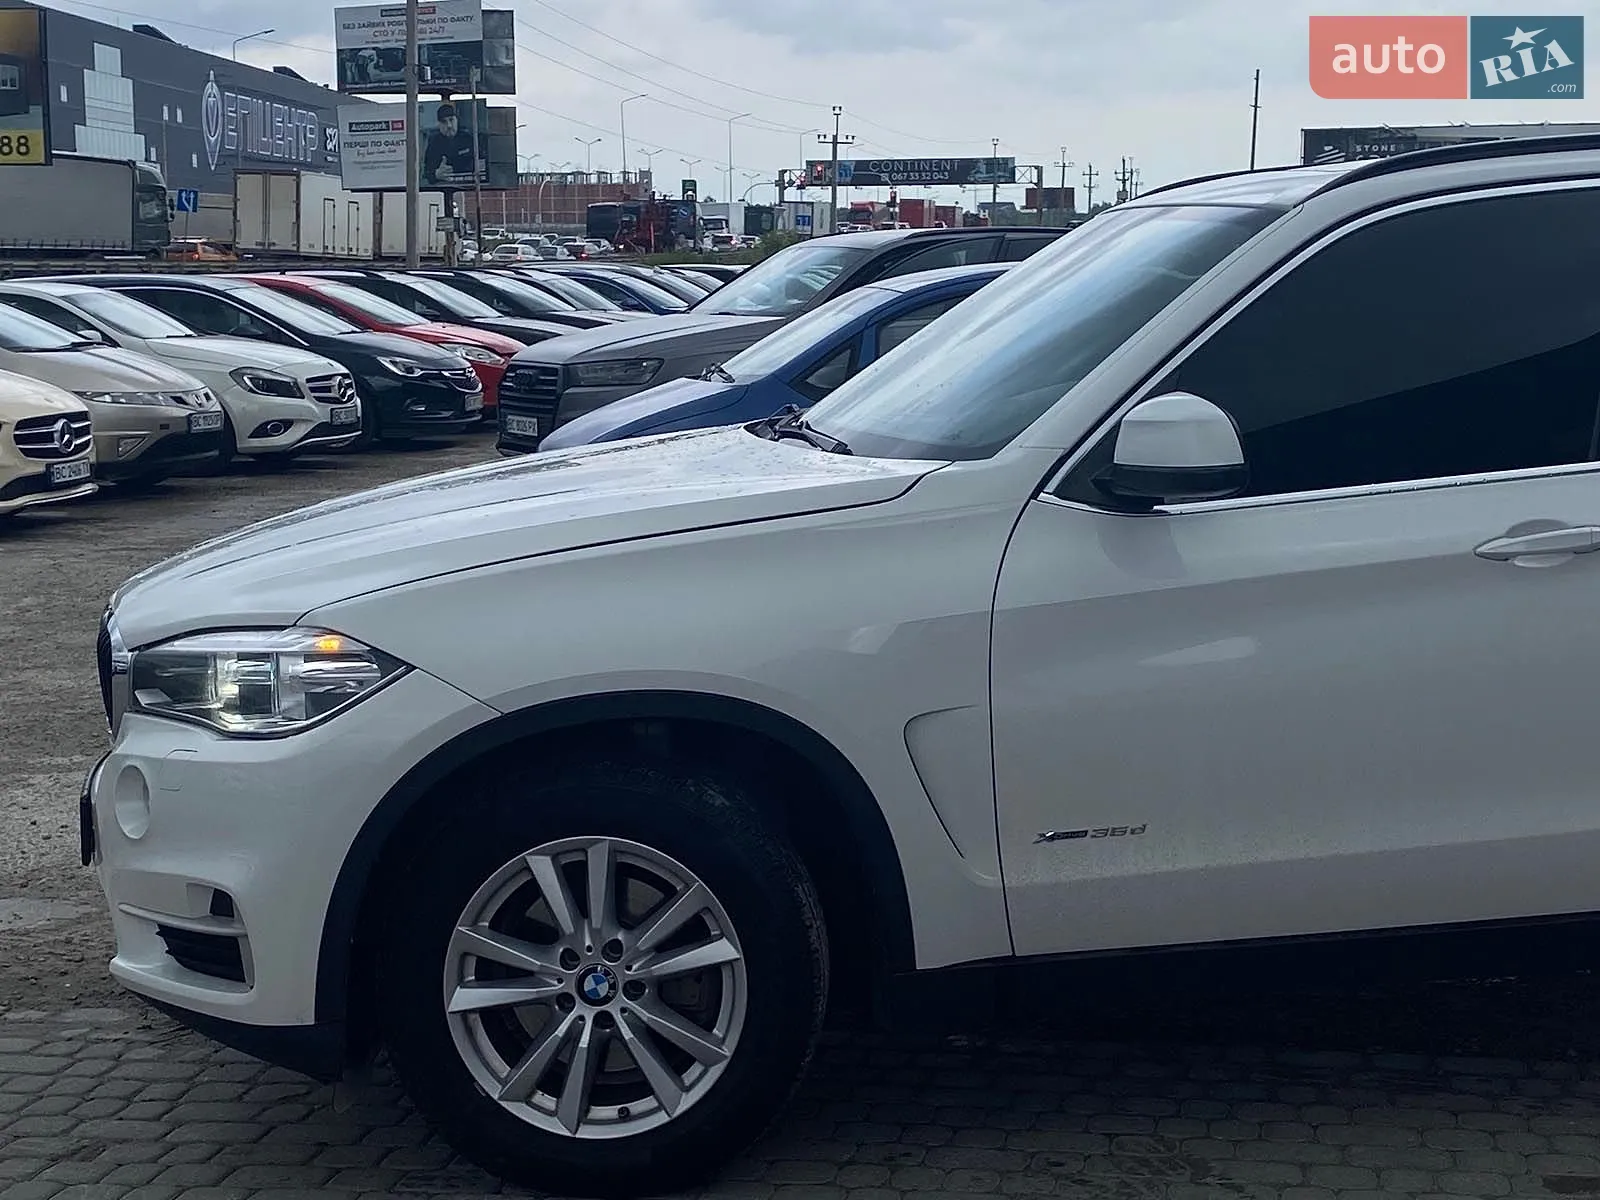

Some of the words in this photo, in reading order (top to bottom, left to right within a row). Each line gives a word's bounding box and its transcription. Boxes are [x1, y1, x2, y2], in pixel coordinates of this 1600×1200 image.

[224, 91, 320, 163] ЕПІЦЕНТР
[0, 135, 30, 157] 88
[1355, 143, 1397, 152] STONE
[868, 159, 961, 172] CONTINENT
